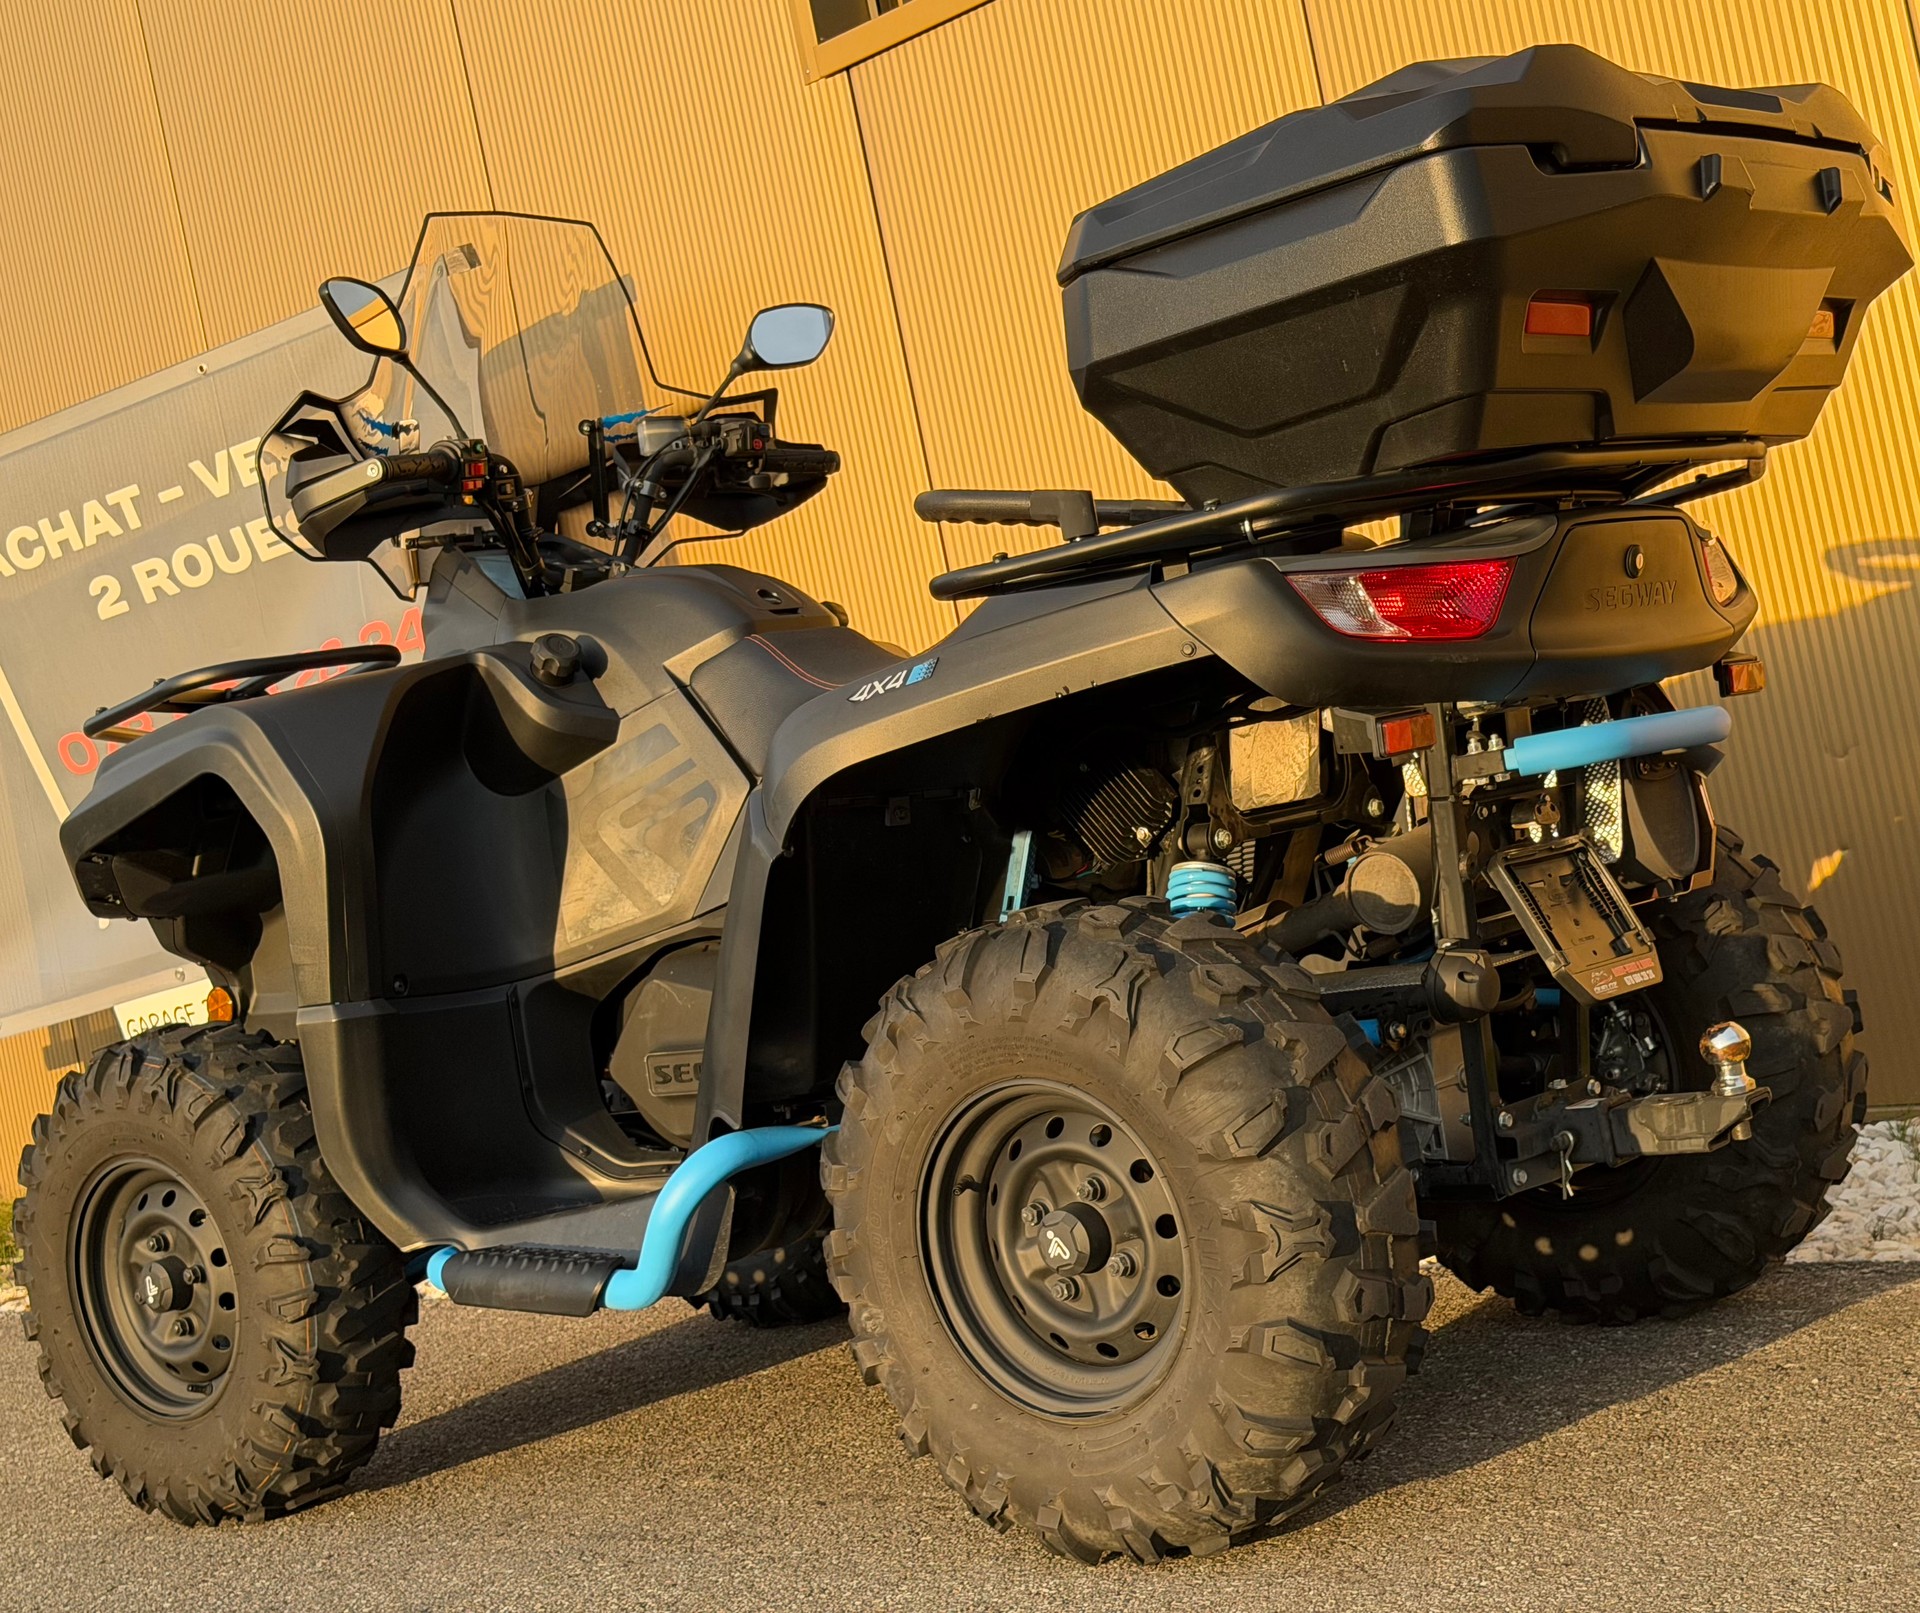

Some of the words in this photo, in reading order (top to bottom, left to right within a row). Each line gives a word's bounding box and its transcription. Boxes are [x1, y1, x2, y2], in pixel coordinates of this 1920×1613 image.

[158, 485, 184, 504] -
[188, 437, 270, 498] VE
[89, 574, 130, 620] 2
[1585, 579, 1678, 612] SEGWAY
